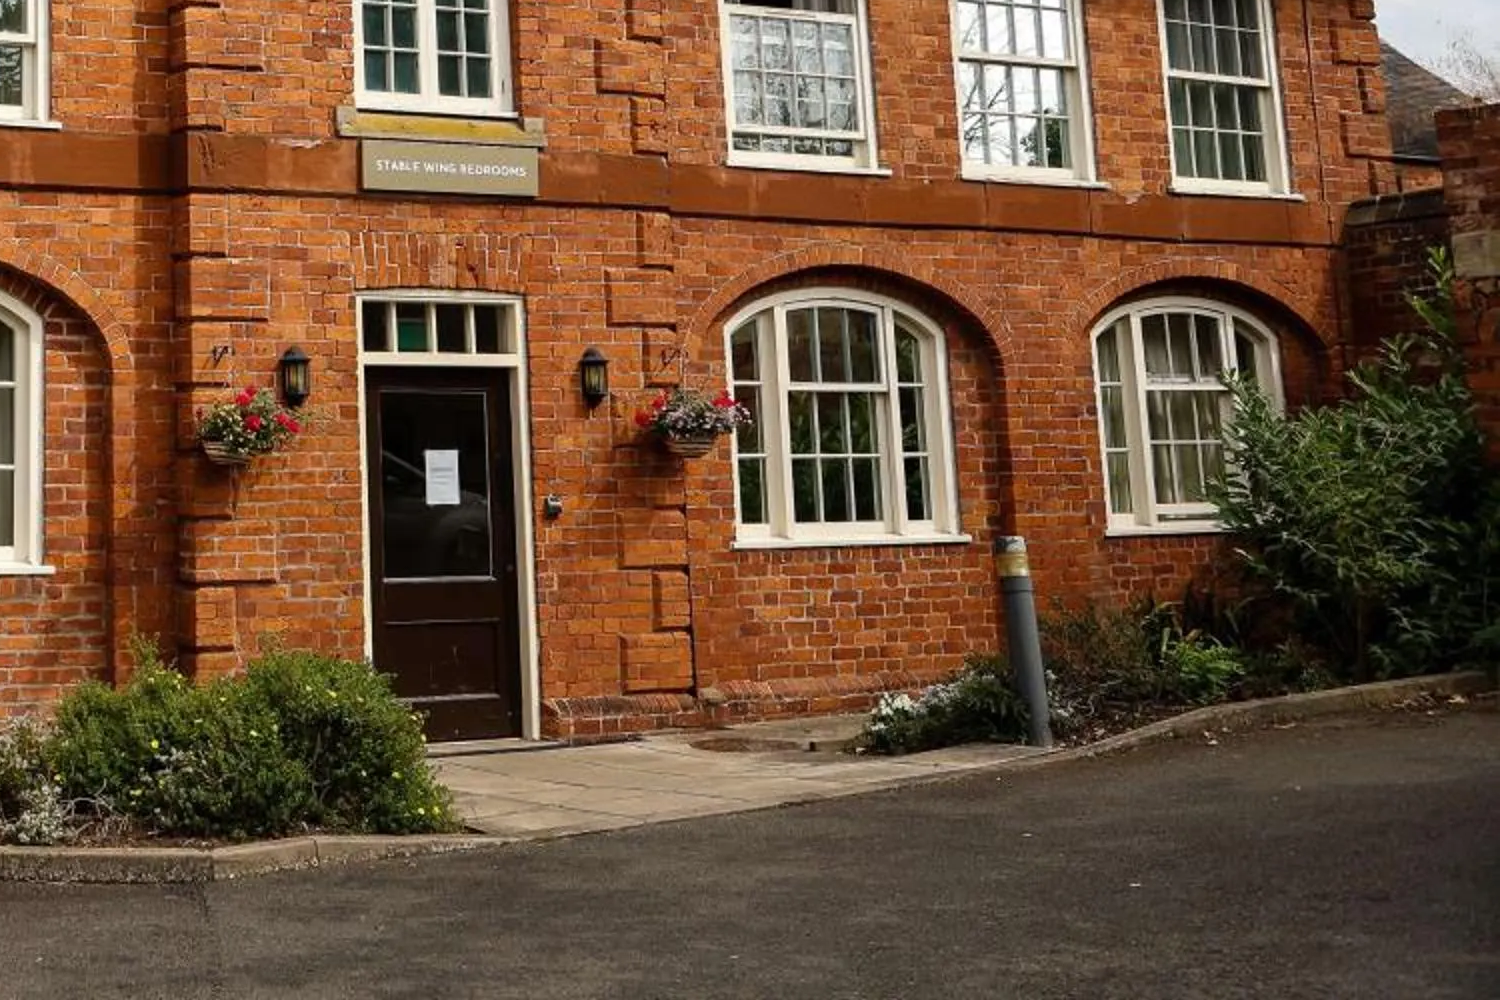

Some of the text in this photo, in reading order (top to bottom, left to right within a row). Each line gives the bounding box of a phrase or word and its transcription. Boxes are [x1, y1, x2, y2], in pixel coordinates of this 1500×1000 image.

[376, 159, 527, 177] STABLE WING BEDROOMS
